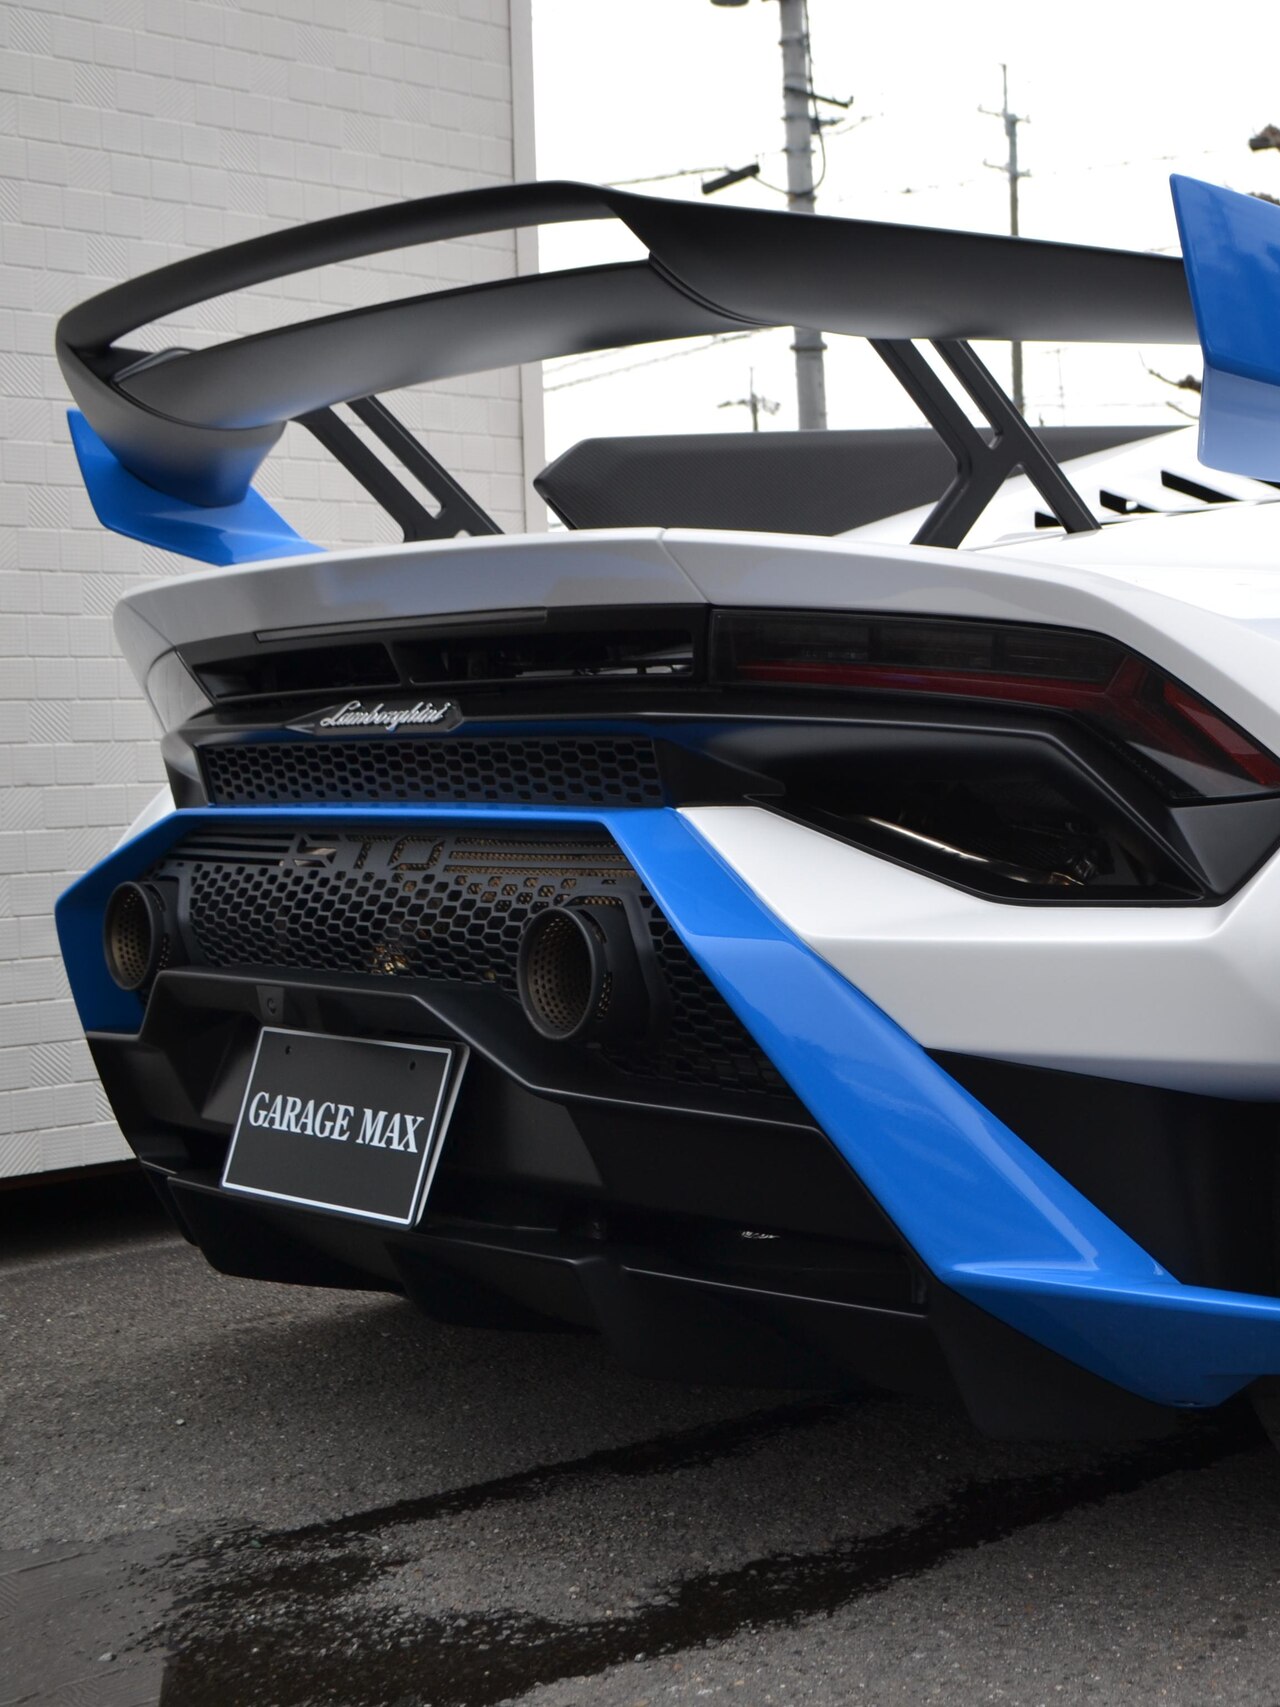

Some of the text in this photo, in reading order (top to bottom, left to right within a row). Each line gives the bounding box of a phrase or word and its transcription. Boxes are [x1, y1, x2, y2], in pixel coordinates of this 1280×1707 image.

[319, 700, 452, 732] Lamborghini
[295, 834, 445, 871] STO
[248, 1091, 425, 1153] GARAGE MAX
